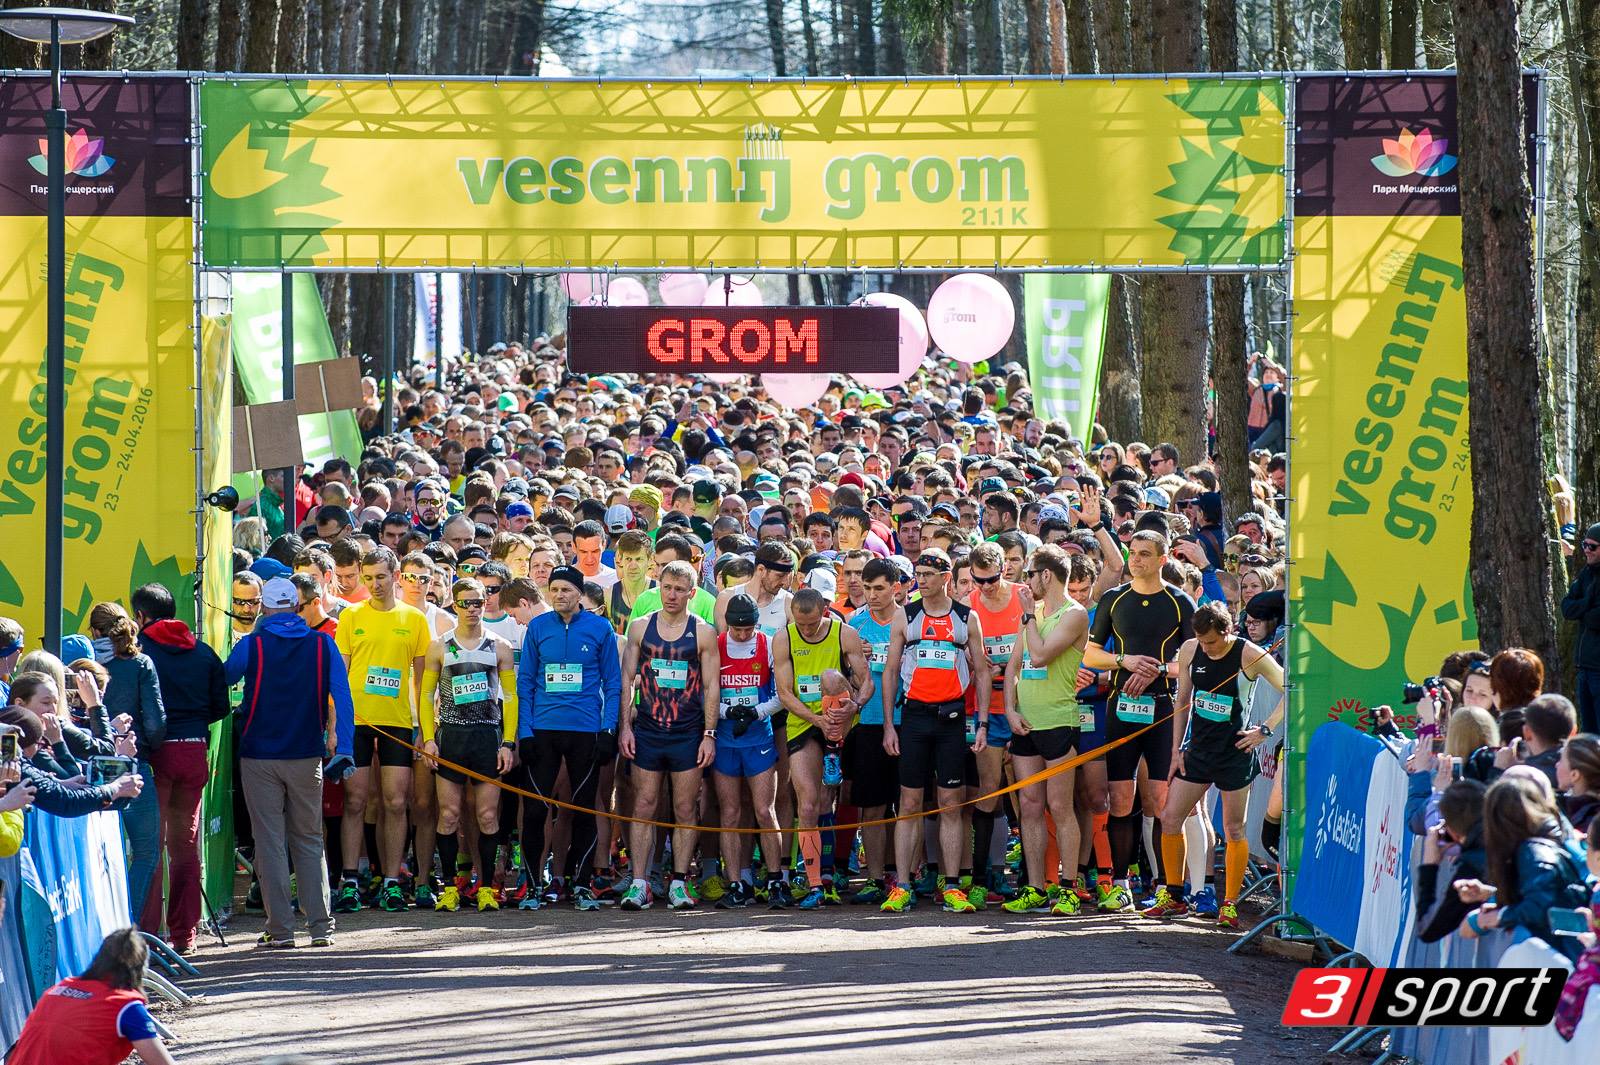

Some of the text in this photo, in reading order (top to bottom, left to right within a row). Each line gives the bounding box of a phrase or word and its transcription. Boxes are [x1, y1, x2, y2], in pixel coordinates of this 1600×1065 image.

[64, 184, 115, 195] ещерский
[823, 152, 1029, 220] grom
[1373, 184, 1457, 195] Парк Мещерский
[647, 319, 818, 362] GROM
[62, 376, 133, 545] grom
[1384, 376, 1470, 545] grom
[934, 651, 947, 659] 62
[1000, 645, 1011, 654] 61
[376, 677, 400, 688] 1100
[561, 673, 574, 682] 52
[721, 674, 761, 686] RUSSIA
[463, 682, 487, 692] 1240
[738, 697, 751, 706] 98
[1131, 704, 1149, 714] 114
[1208, 702, 1227, 713] 595
